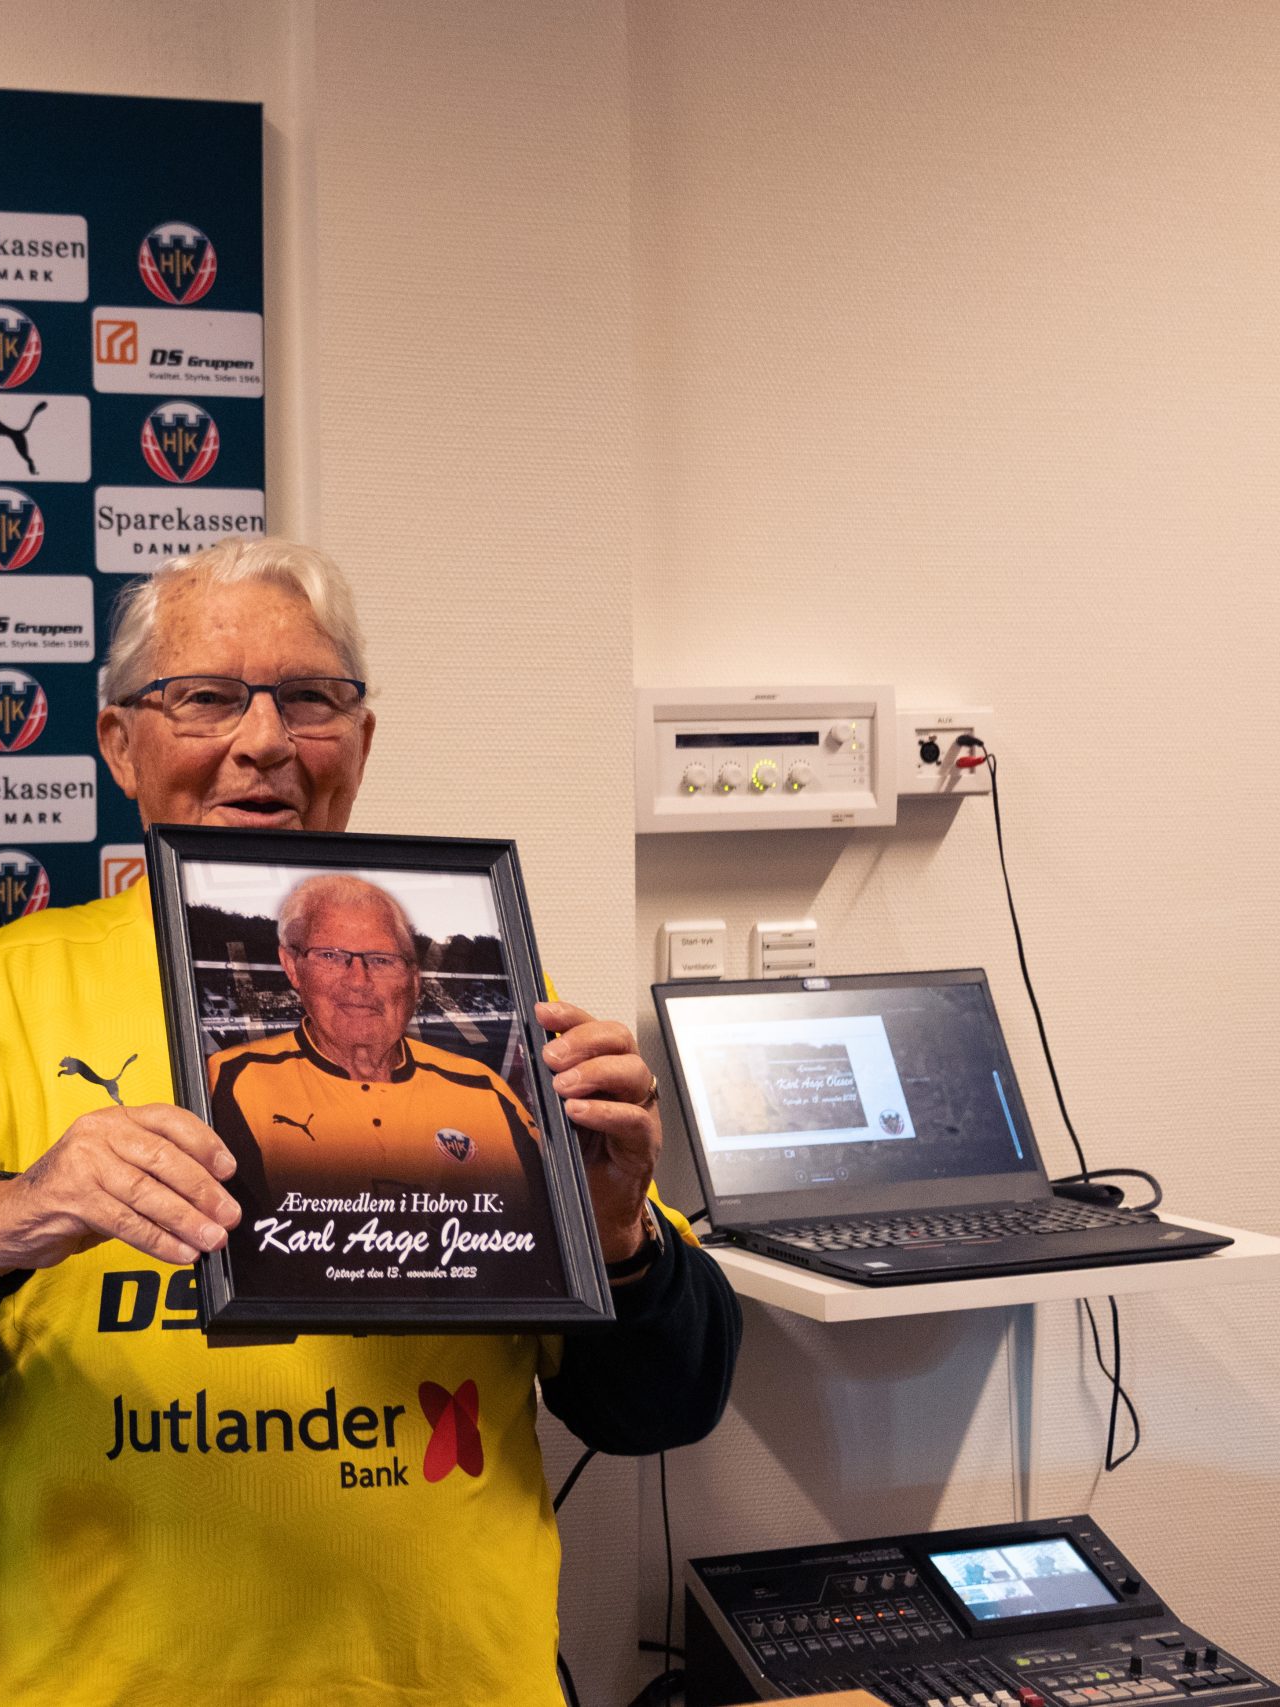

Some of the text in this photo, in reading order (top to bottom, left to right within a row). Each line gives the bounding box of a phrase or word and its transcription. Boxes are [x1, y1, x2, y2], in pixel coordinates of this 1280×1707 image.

[150, 349, 254, 370] DS Gruppen
[98, 506, 264, 536] Sparekassen
[14, 623, 83, 636] Gruppen
[11, 640, 38, 648] Styrke.
[43, 640, 65, 648] Siden
[277, 1193, 503, 1212] Æresmedlem i Hobro IK:
[254, 1217, 535, 1264] Karl Aage Jensen
[367, 1268, 384, 1278] den
[387, 1266, 401, 1278] 13.
[407, 1266, 447, 1278] november
[450, 1266, 477, 1278] 2023
[107, 1387, 406, 1460] Jutlander
[339, 1456, 410, 1490] Bank
